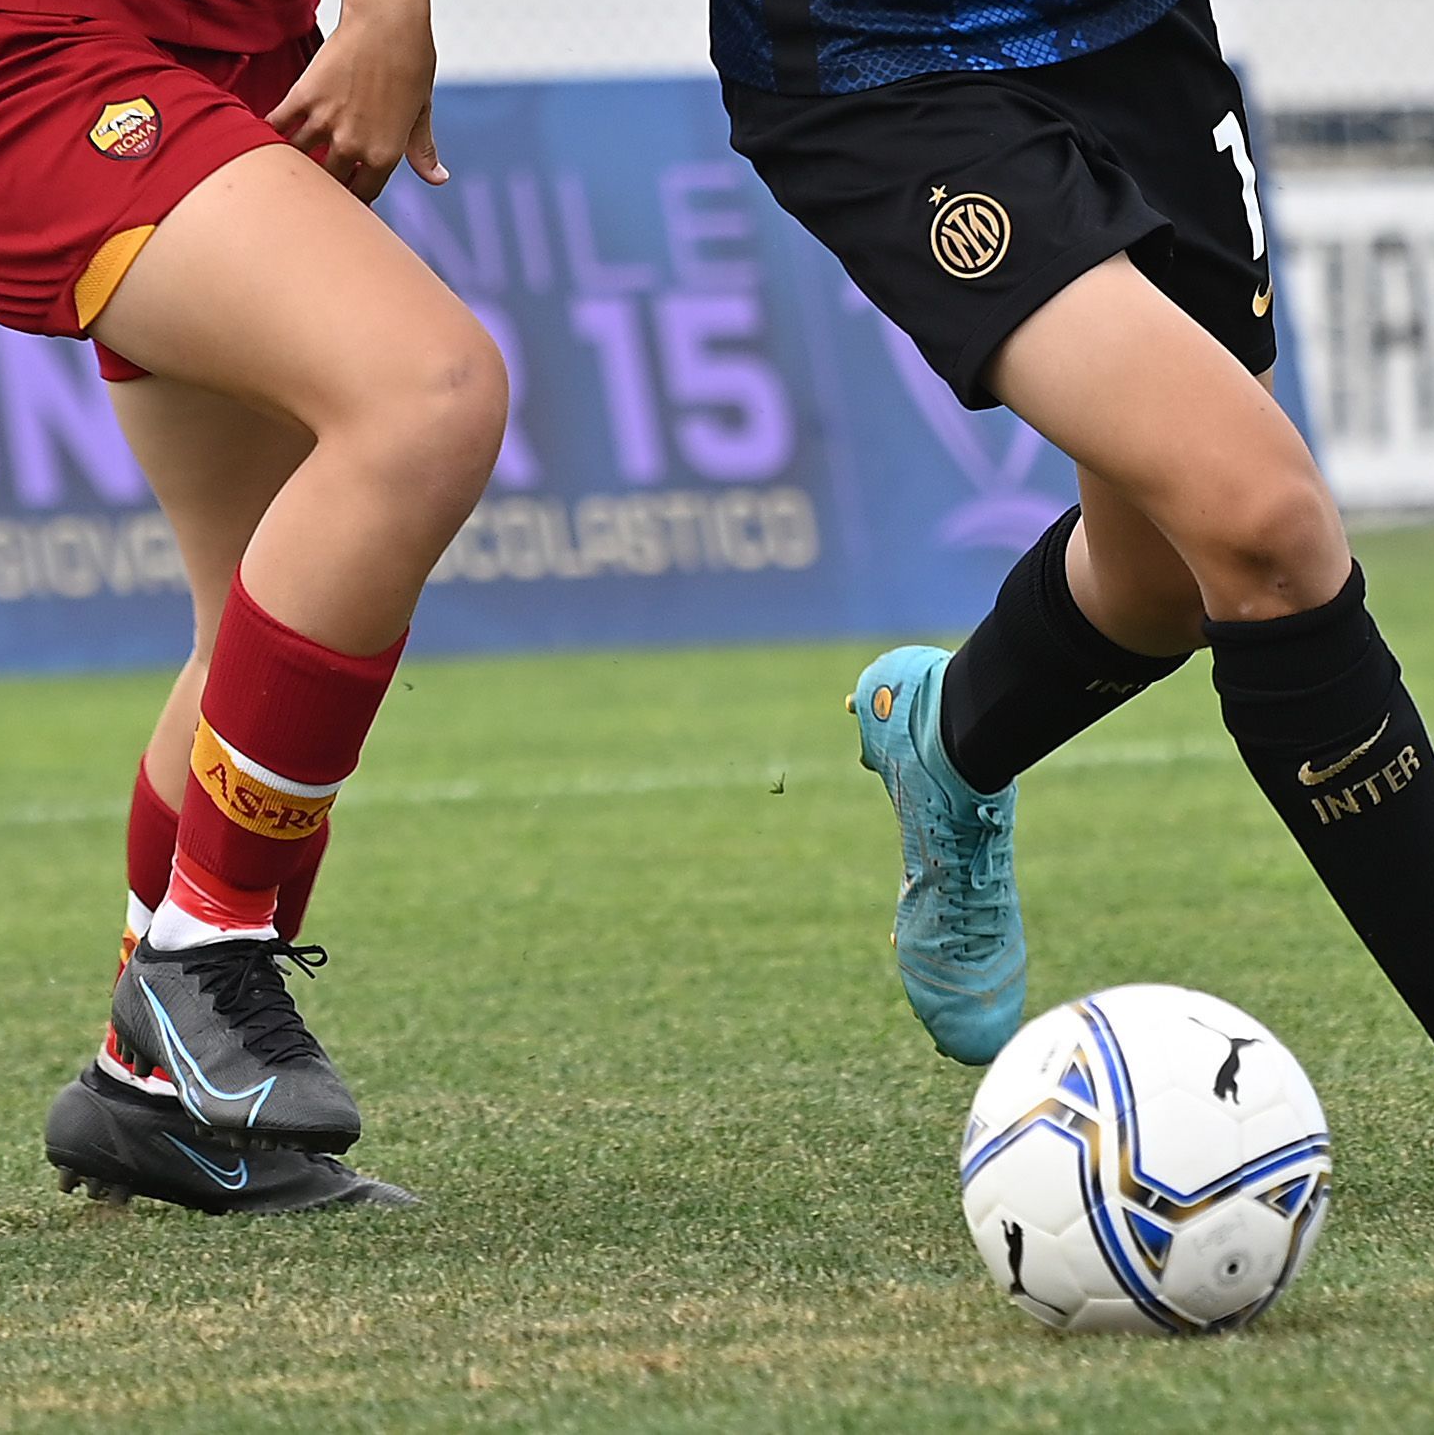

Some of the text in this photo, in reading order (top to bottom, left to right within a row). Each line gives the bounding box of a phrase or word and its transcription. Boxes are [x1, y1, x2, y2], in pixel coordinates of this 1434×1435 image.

[113, 122, 158, 156] ROMA
[571, 293, 797, 486] 15
[1310, 744, 1421, 826] INTER
